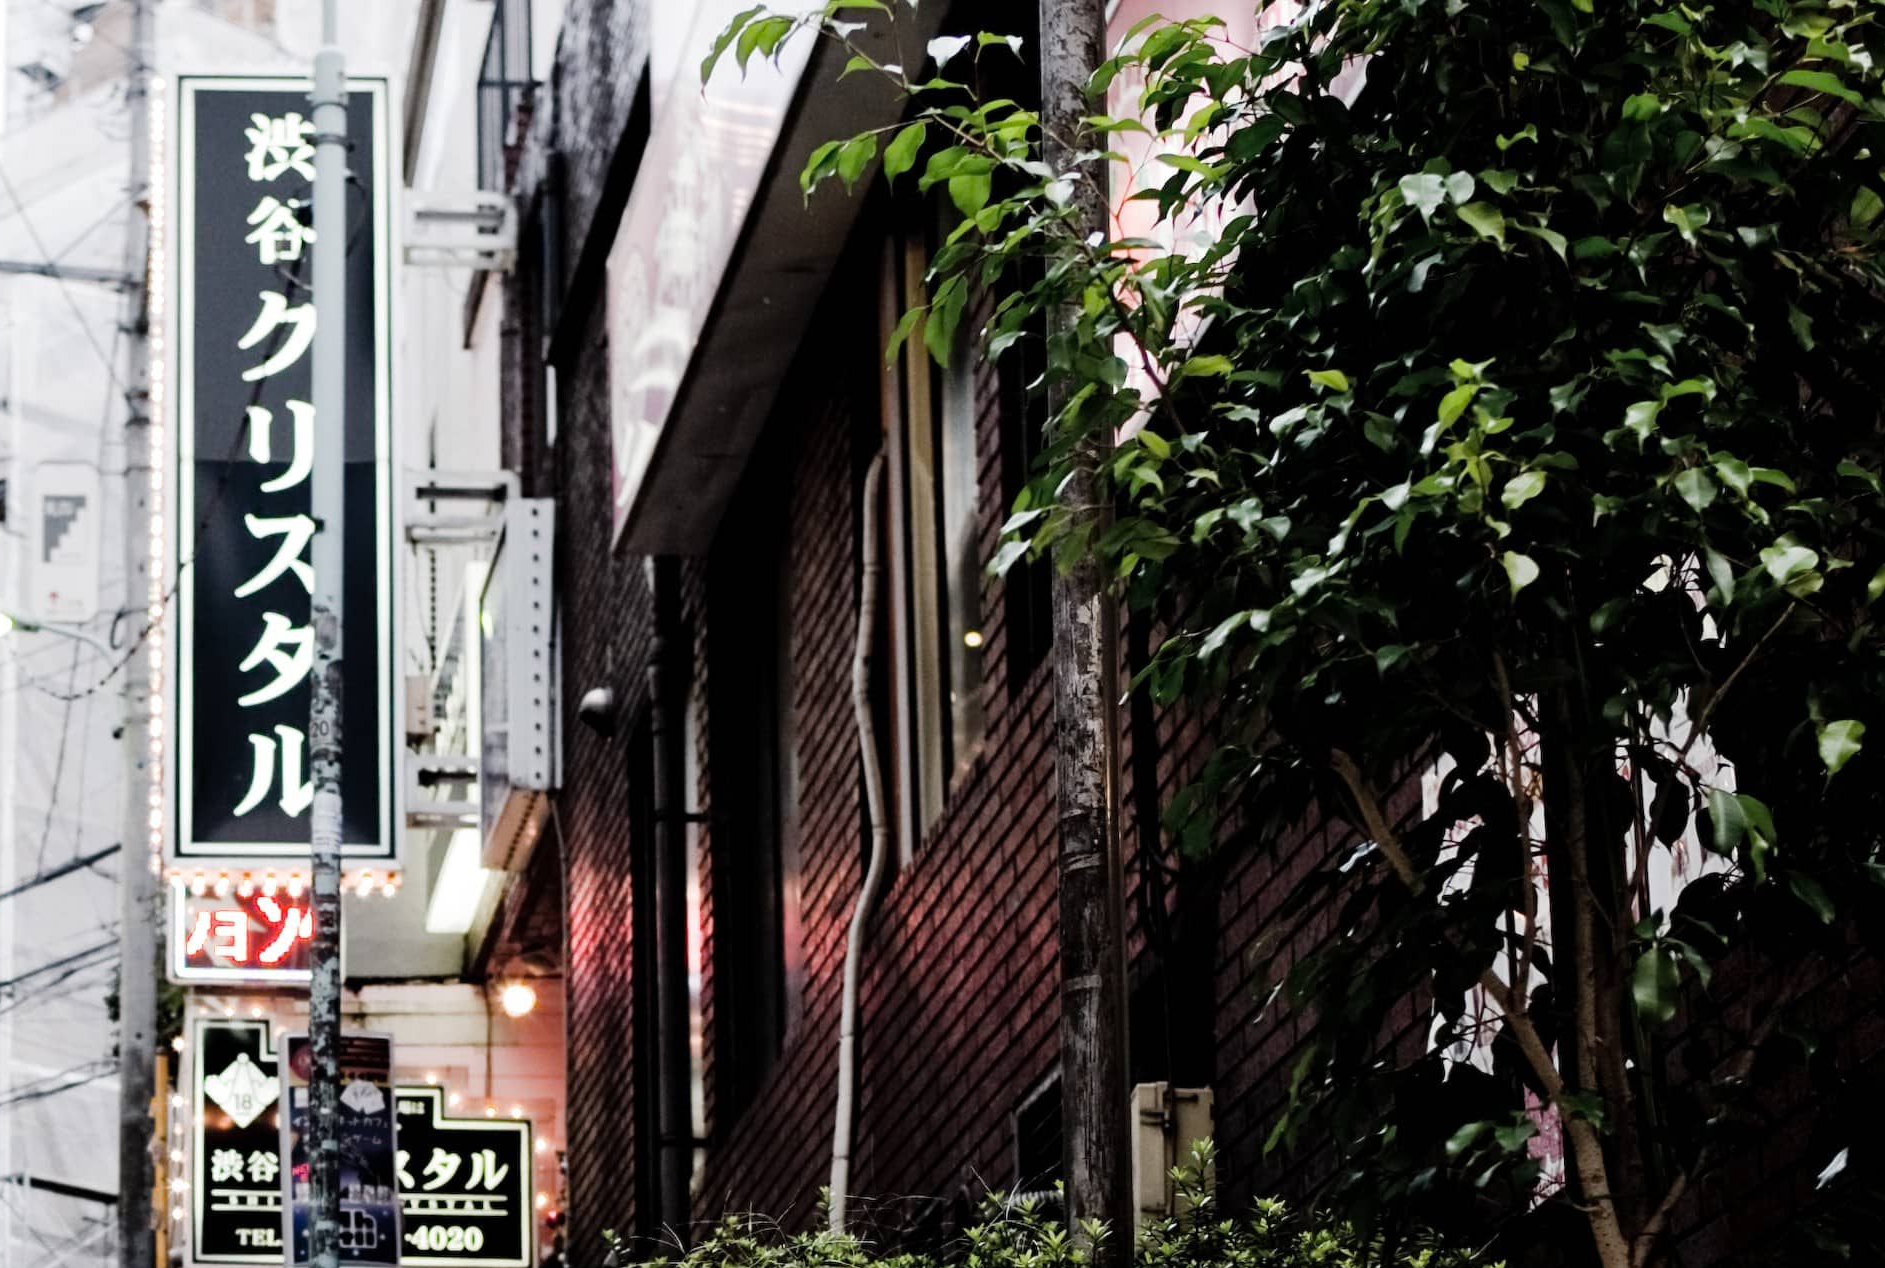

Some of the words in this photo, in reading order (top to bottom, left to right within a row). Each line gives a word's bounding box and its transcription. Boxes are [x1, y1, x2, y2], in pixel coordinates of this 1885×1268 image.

[233, 111, 316, 820] 渋谷クリスタル
